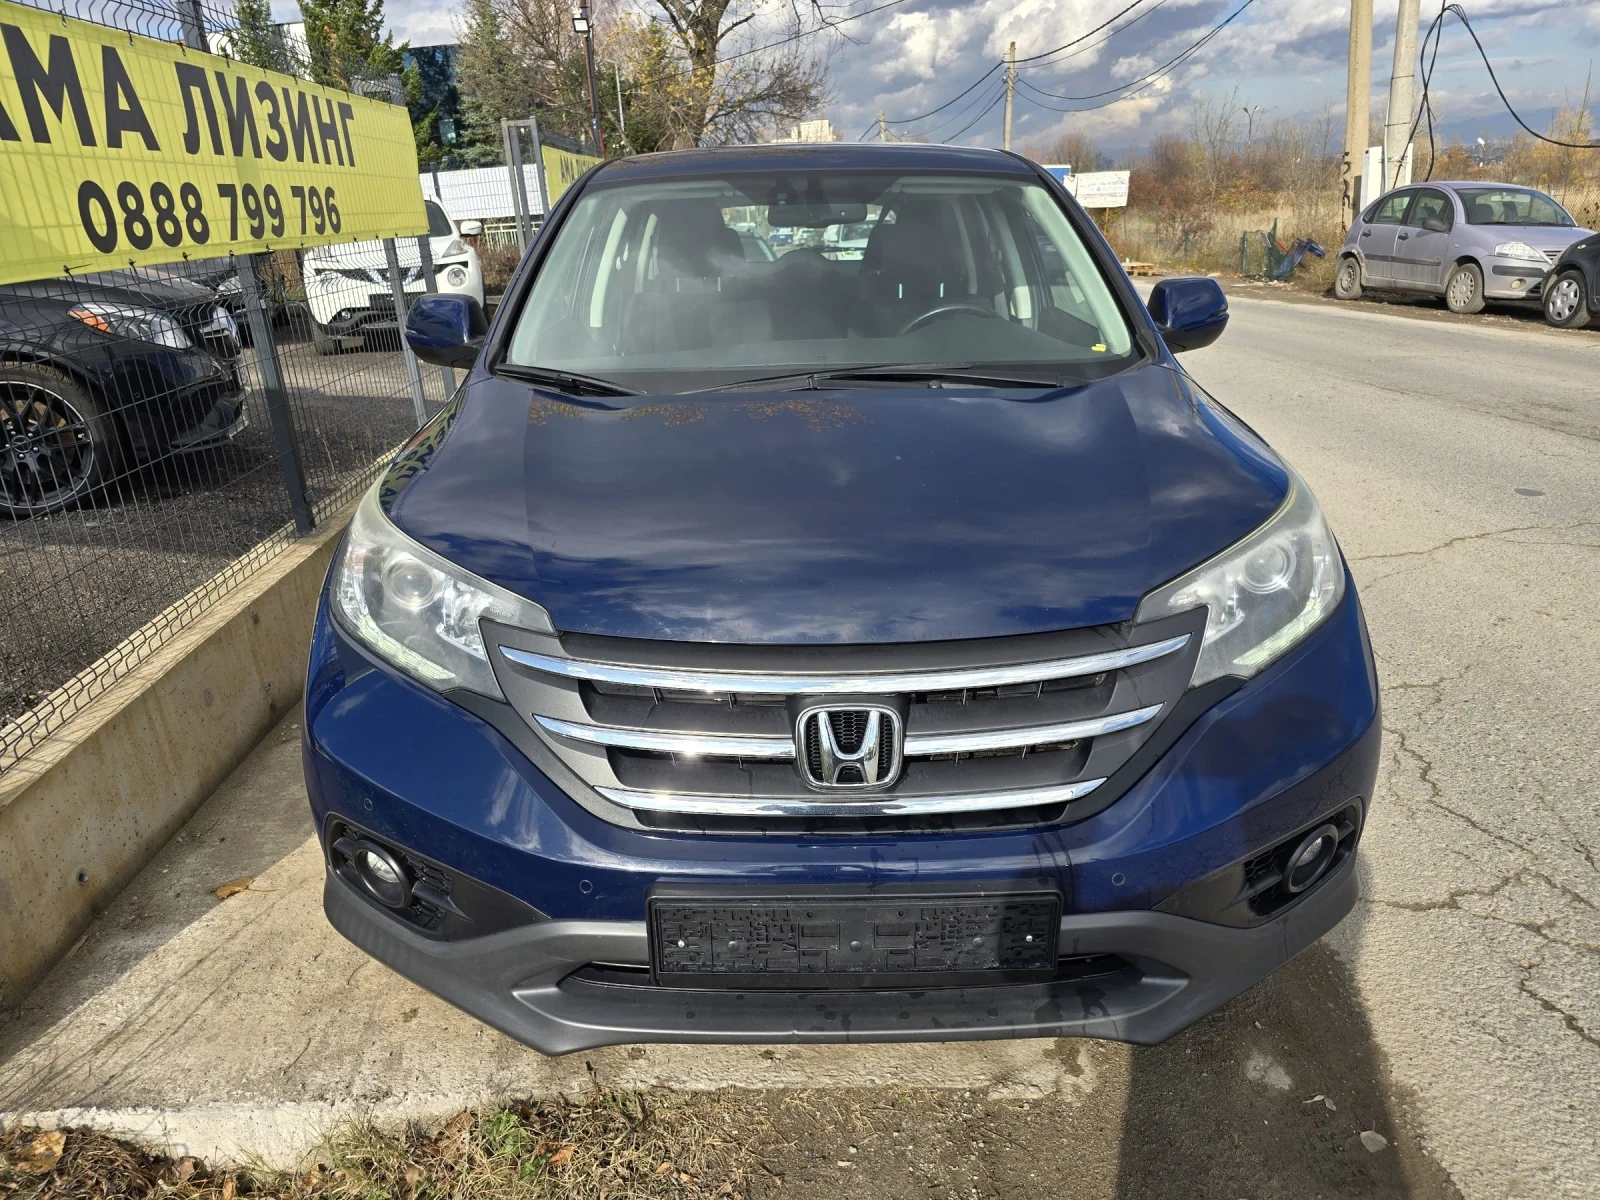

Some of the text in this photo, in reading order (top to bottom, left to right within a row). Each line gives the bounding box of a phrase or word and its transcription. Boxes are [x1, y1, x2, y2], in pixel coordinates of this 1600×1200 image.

[175, 62, 356, 168] ЛИЗИНГ
[77, 180, 342, 254] 0888 799 796
